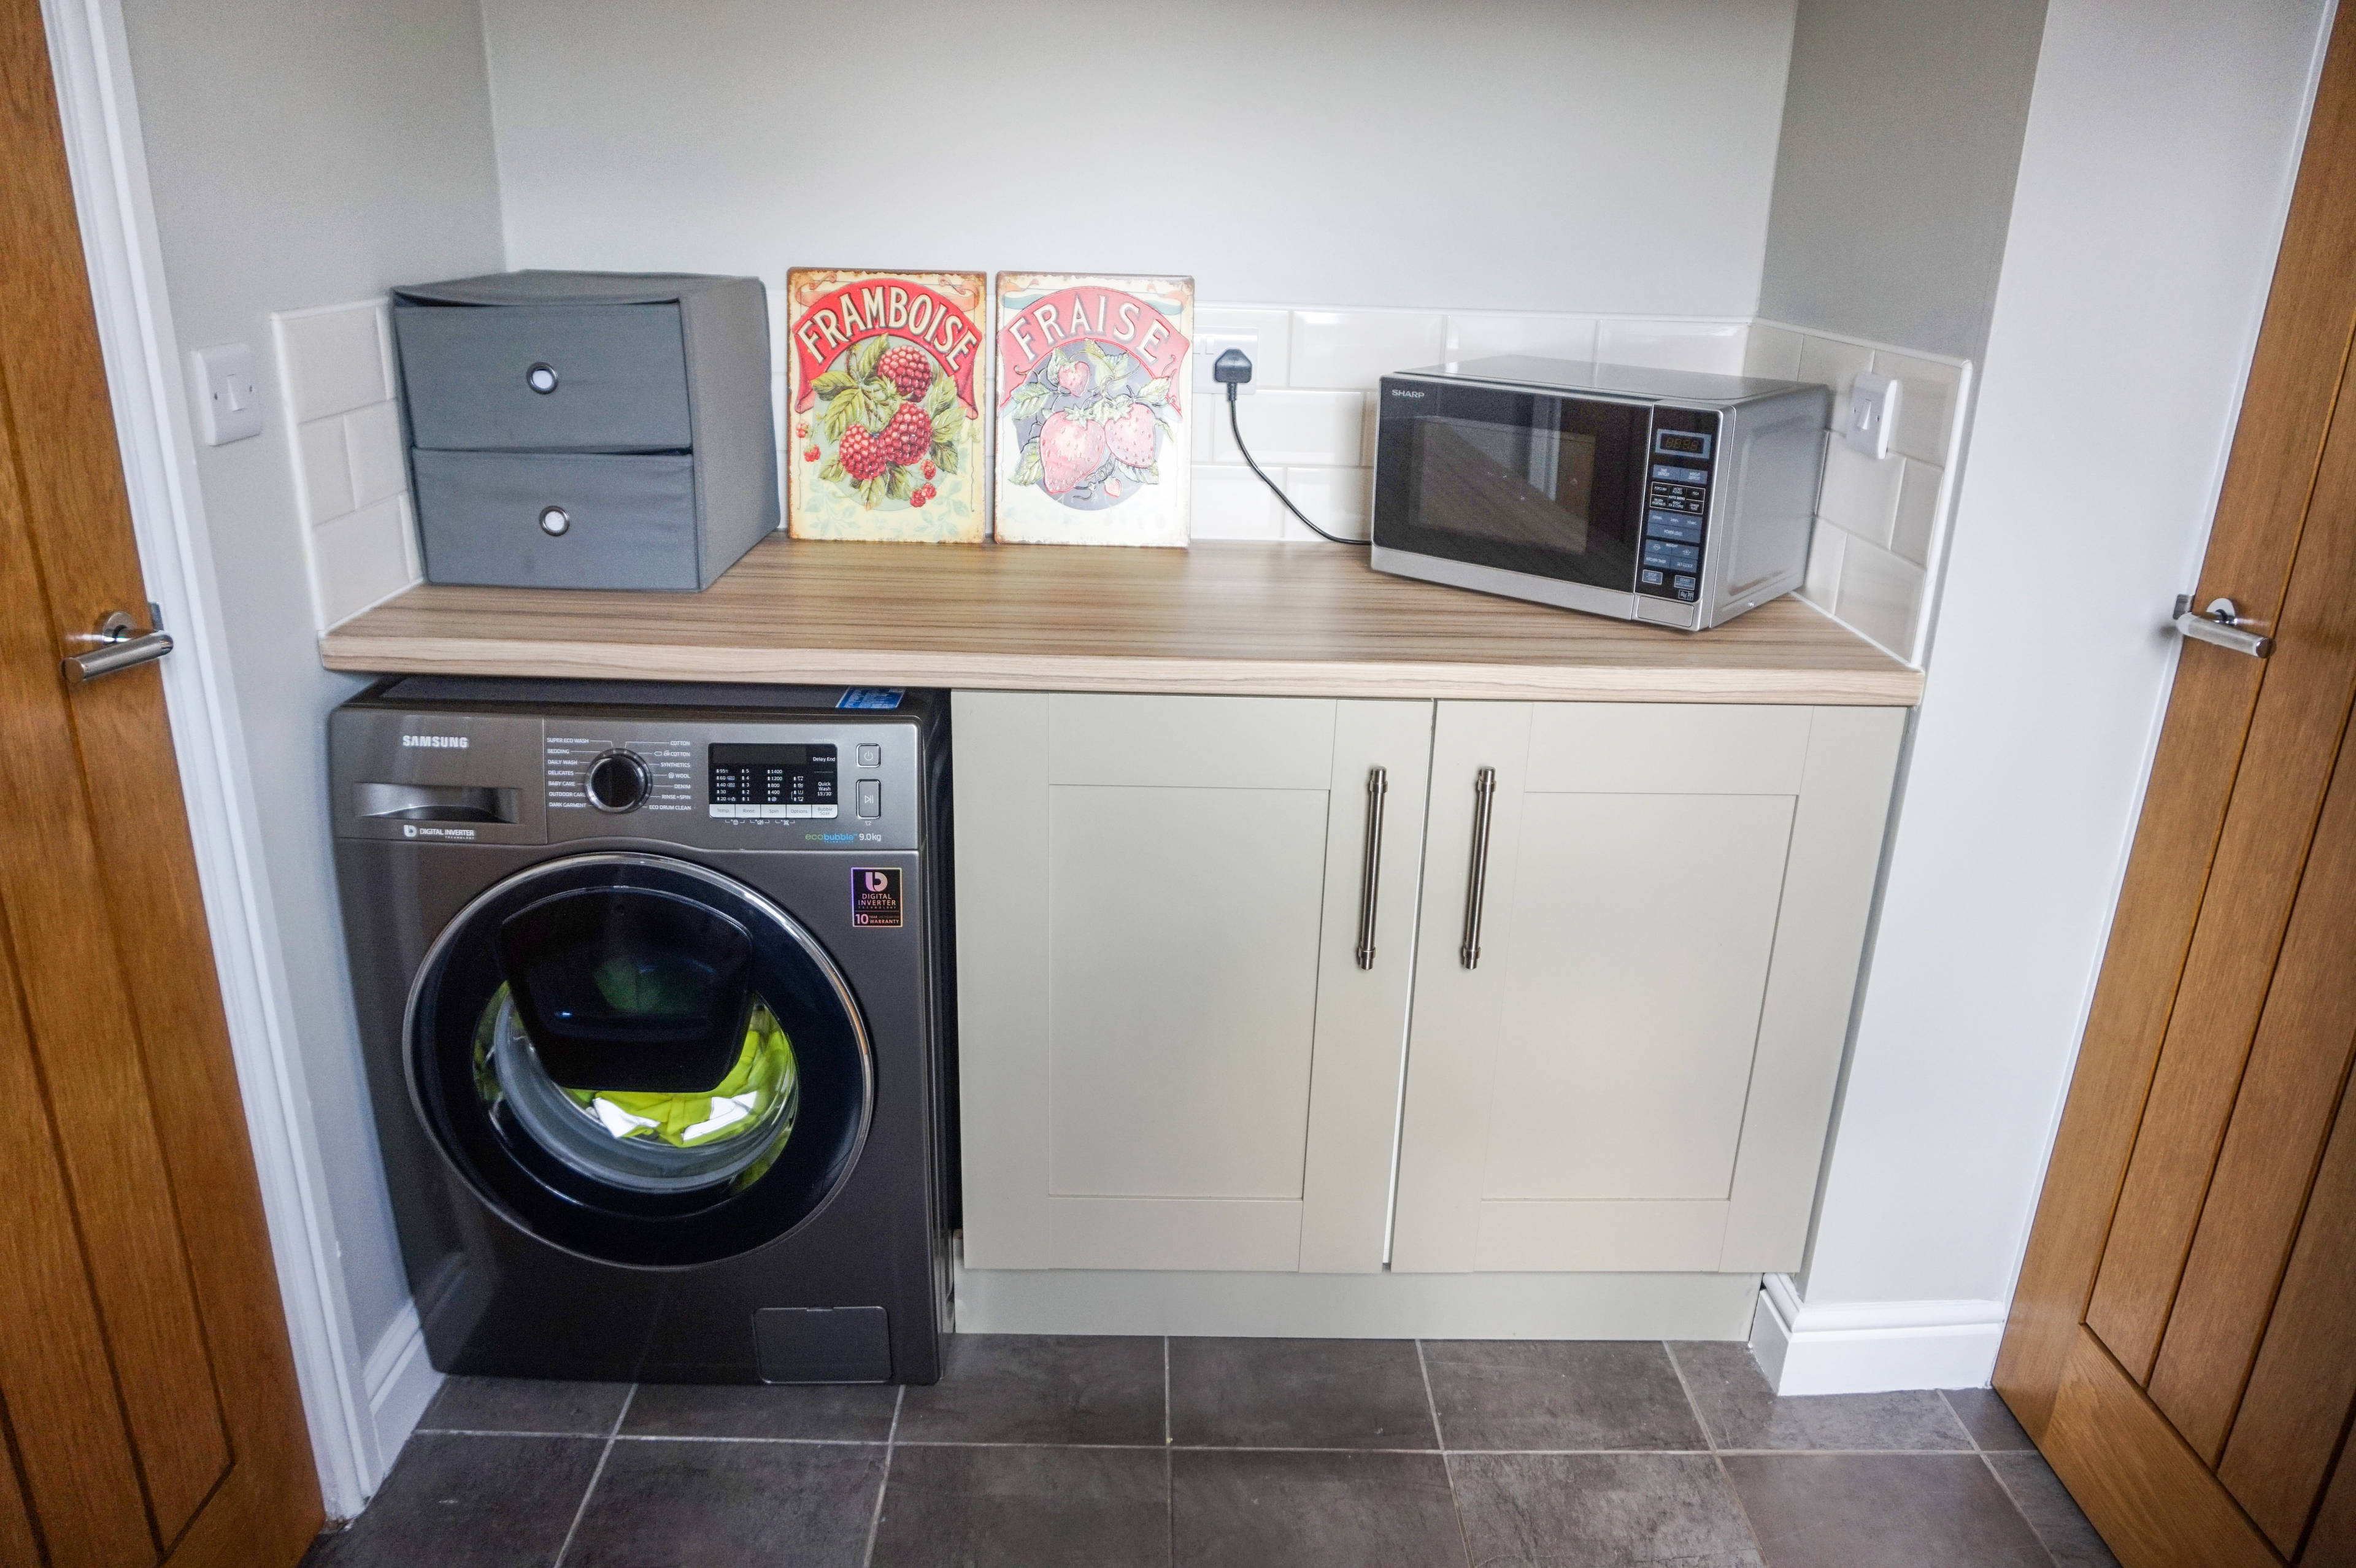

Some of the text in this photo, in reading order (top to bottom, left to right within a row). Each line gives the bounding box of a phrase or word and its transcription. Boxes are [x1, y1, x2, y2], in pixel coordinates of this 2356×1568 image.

[797, 285, 978, 372] FRAMBOISE
[1007, 293, 1171, 364] FRAISE
[1392, 389, 1425, 398] SHARP
[402, 736, 469, 748] SAMSUNG
[859, 833, 882, 842] 9.0kg
[855, 913, 869, 924] 10
